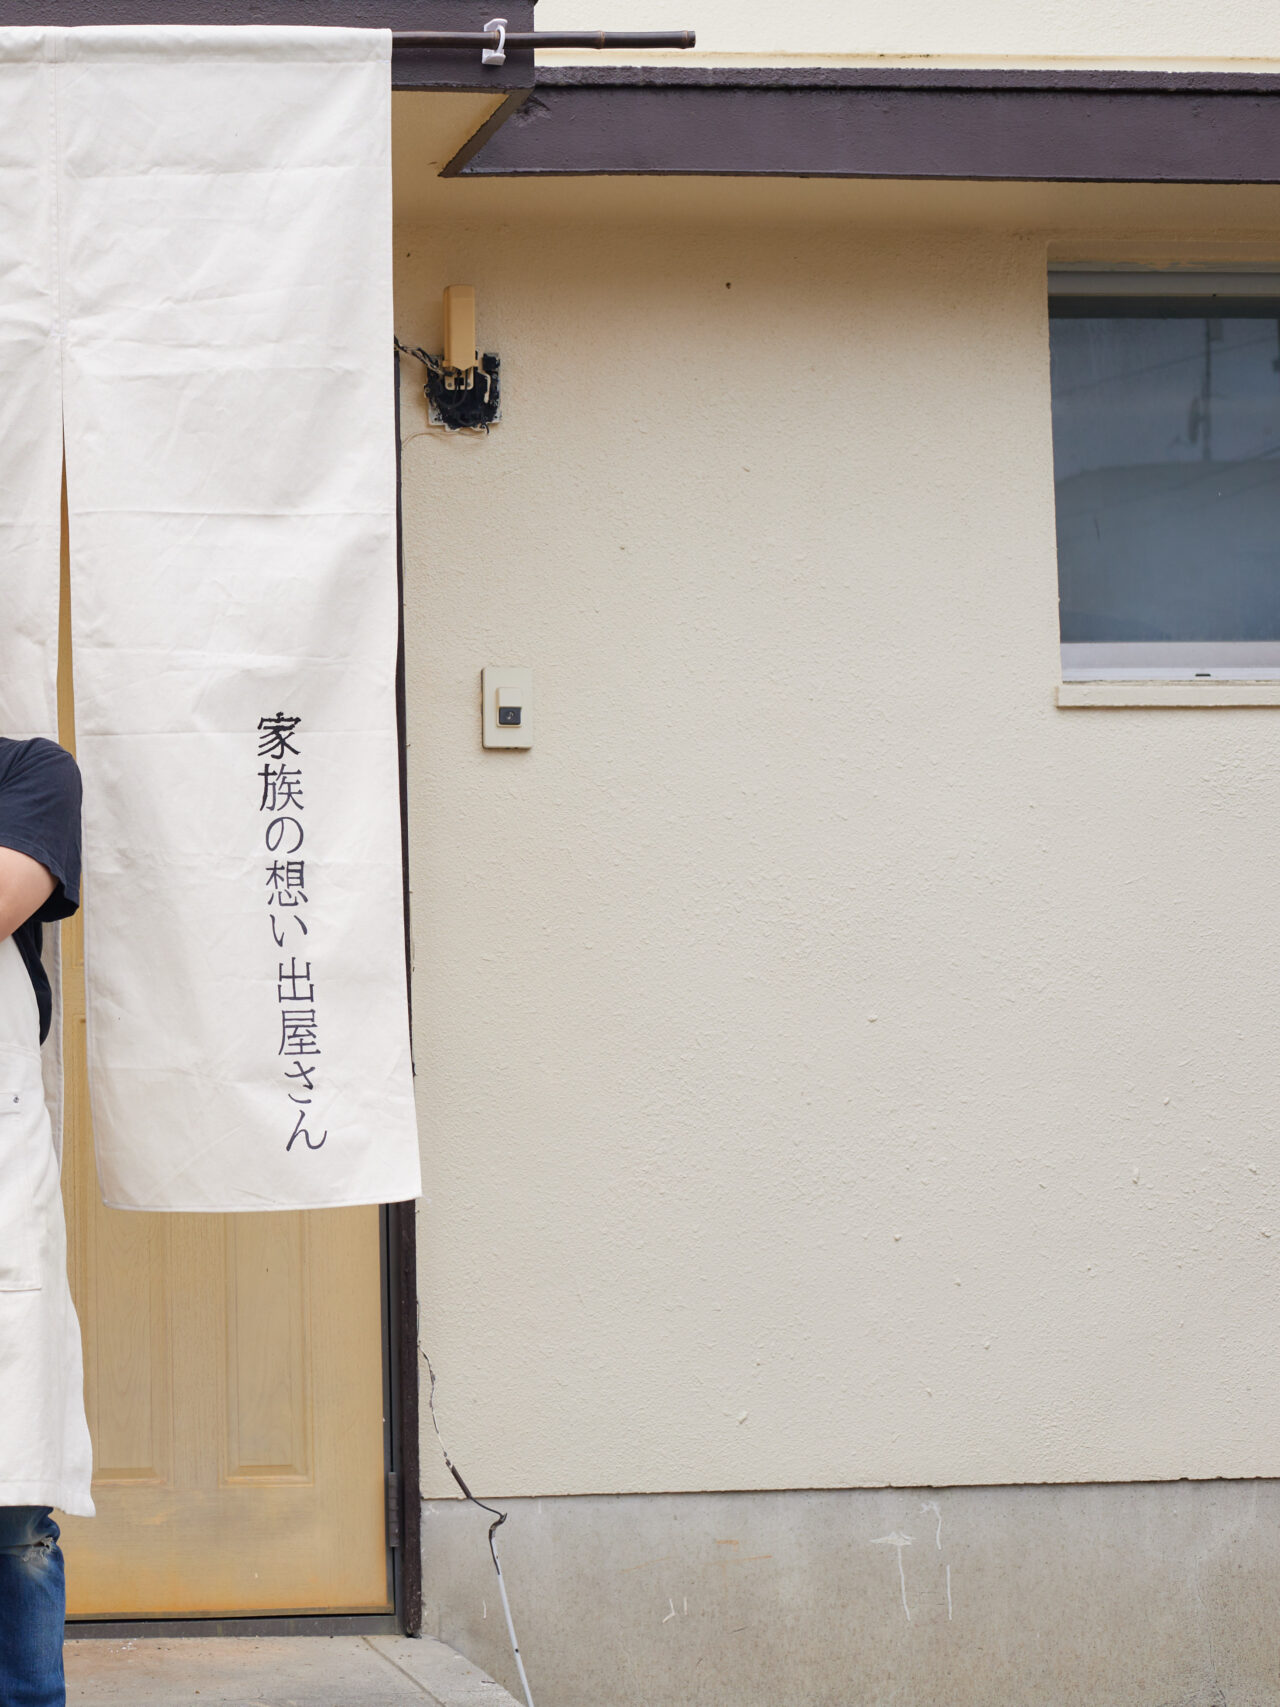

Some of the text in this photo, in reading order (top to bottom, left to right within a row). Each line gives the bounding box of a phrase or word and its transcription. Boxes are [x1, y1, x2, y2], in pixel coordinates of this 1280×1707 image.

[257, 711, 328, 1152] 家族の想い出屋さん
